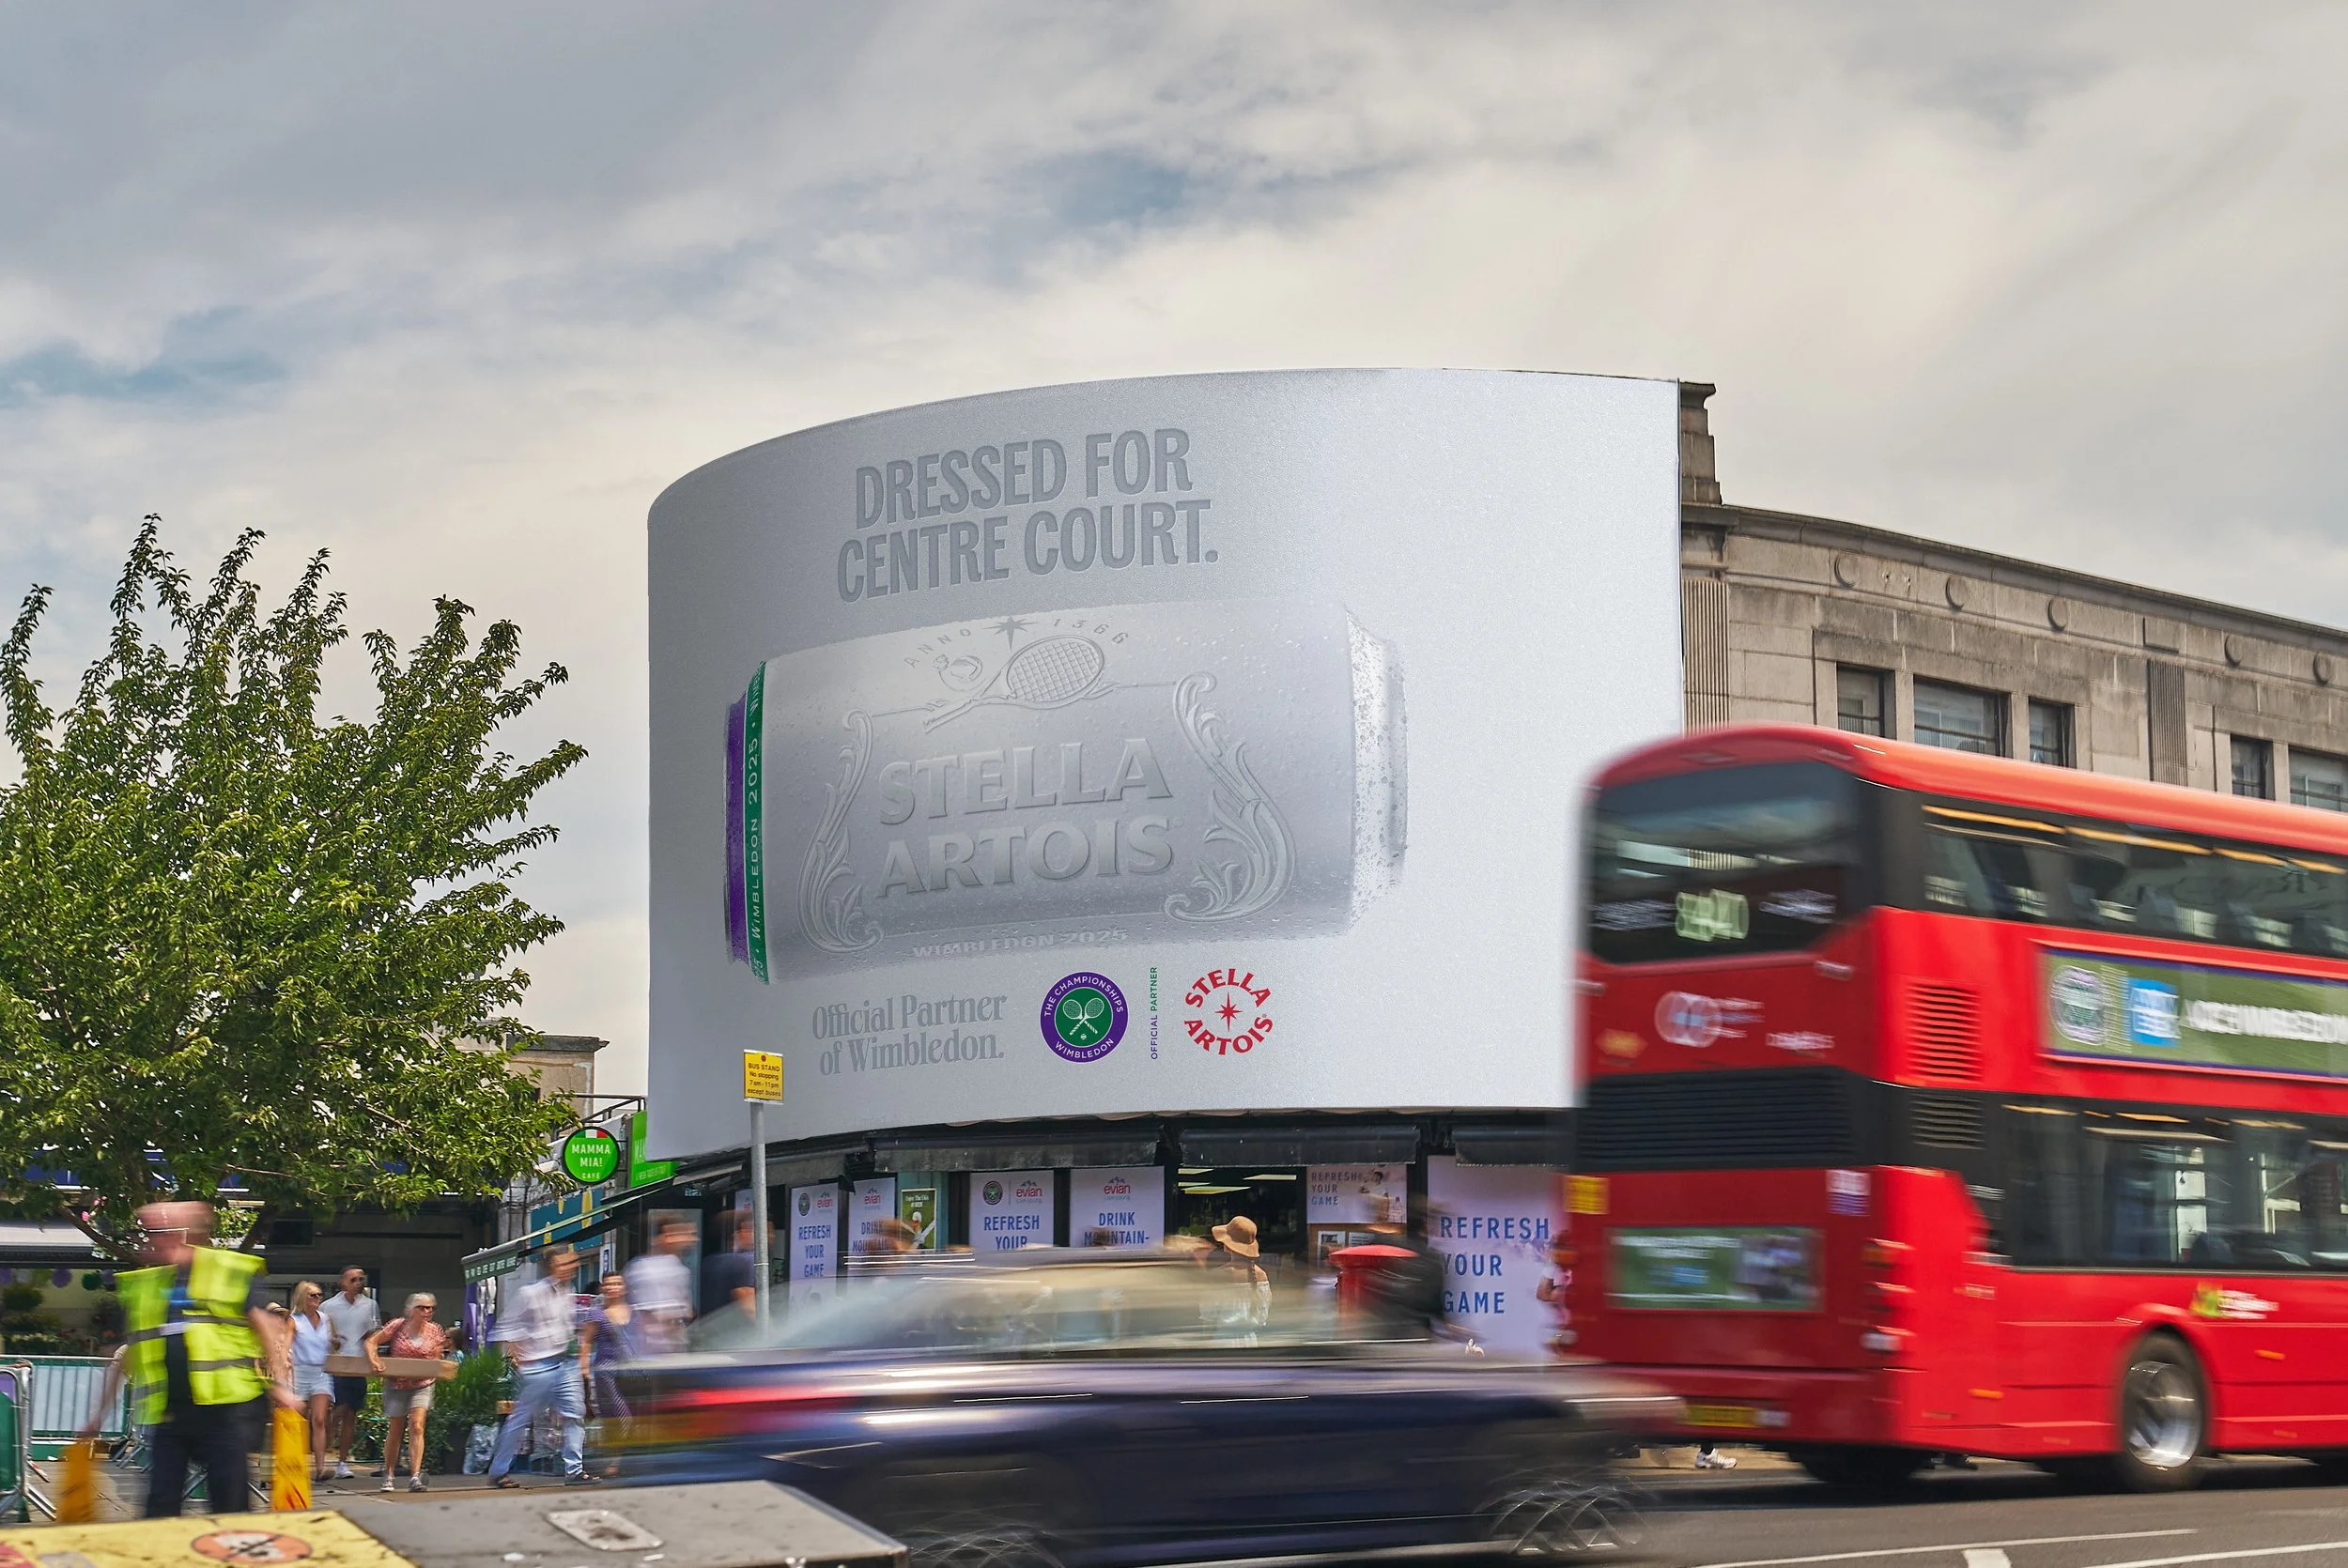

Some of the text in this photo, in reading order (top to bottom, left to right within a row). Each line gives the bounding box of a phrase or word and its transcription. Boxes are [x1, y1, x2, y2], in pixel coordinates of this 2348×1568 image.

[857, 428, 1194, 530] DRESSED FOR
[837, 500, 1219, 603] CENTRE COURT.
[904, 618, 1129, 669] ANNO 1366
[748, 737, 759, 806] 2025
[878, 738, 1174, 825] STELLA
[750, 818, 761, 940] WIMBLEDON
[1043, 976, 1124, 1017] THE CHAMPIONSHIPS
[1150, 966, 1158, 1012] PARTNER
[1184, 968, 1272, 1008] STELLA
[812, 993, 1008, 1040] Official Partner
[819, 1026, 1005, 1077] of Wimbledon.
[1054, 1038, 1115, 1060] WIMBLEDON
[748, 1062, 780, 1072] BUS STAND
[758, 1072, 780, 1081] stopping
[571, 1144, 610, 1155] MAMMA
[579, 1157, 603, 1167] MIA!
[1310, 1171, 1358, 1182] REFRESH
[1015, 1186, 1043, 1197] evian
[1104, 1183, 1131, 1194] evian
[1311, 1184, 1338, 1193] YOUR
[1311, 1195, 1339, 1207] GAME
[983, 1215, 1040, 1232] REFRESH
[1098, 1211, 1135, 1226] DRINK
[1440, 1215, 1550, 1240] REFRESH
[798, 1224, 832, 1241] REFRESH
[804, 1244, 825, 1260] YOUR
[803, 1263, 825, 1279] GAME
[1442, 1253, 1503, 1277] YOUR
[1443, 1291, 1506, 1314] GAME
